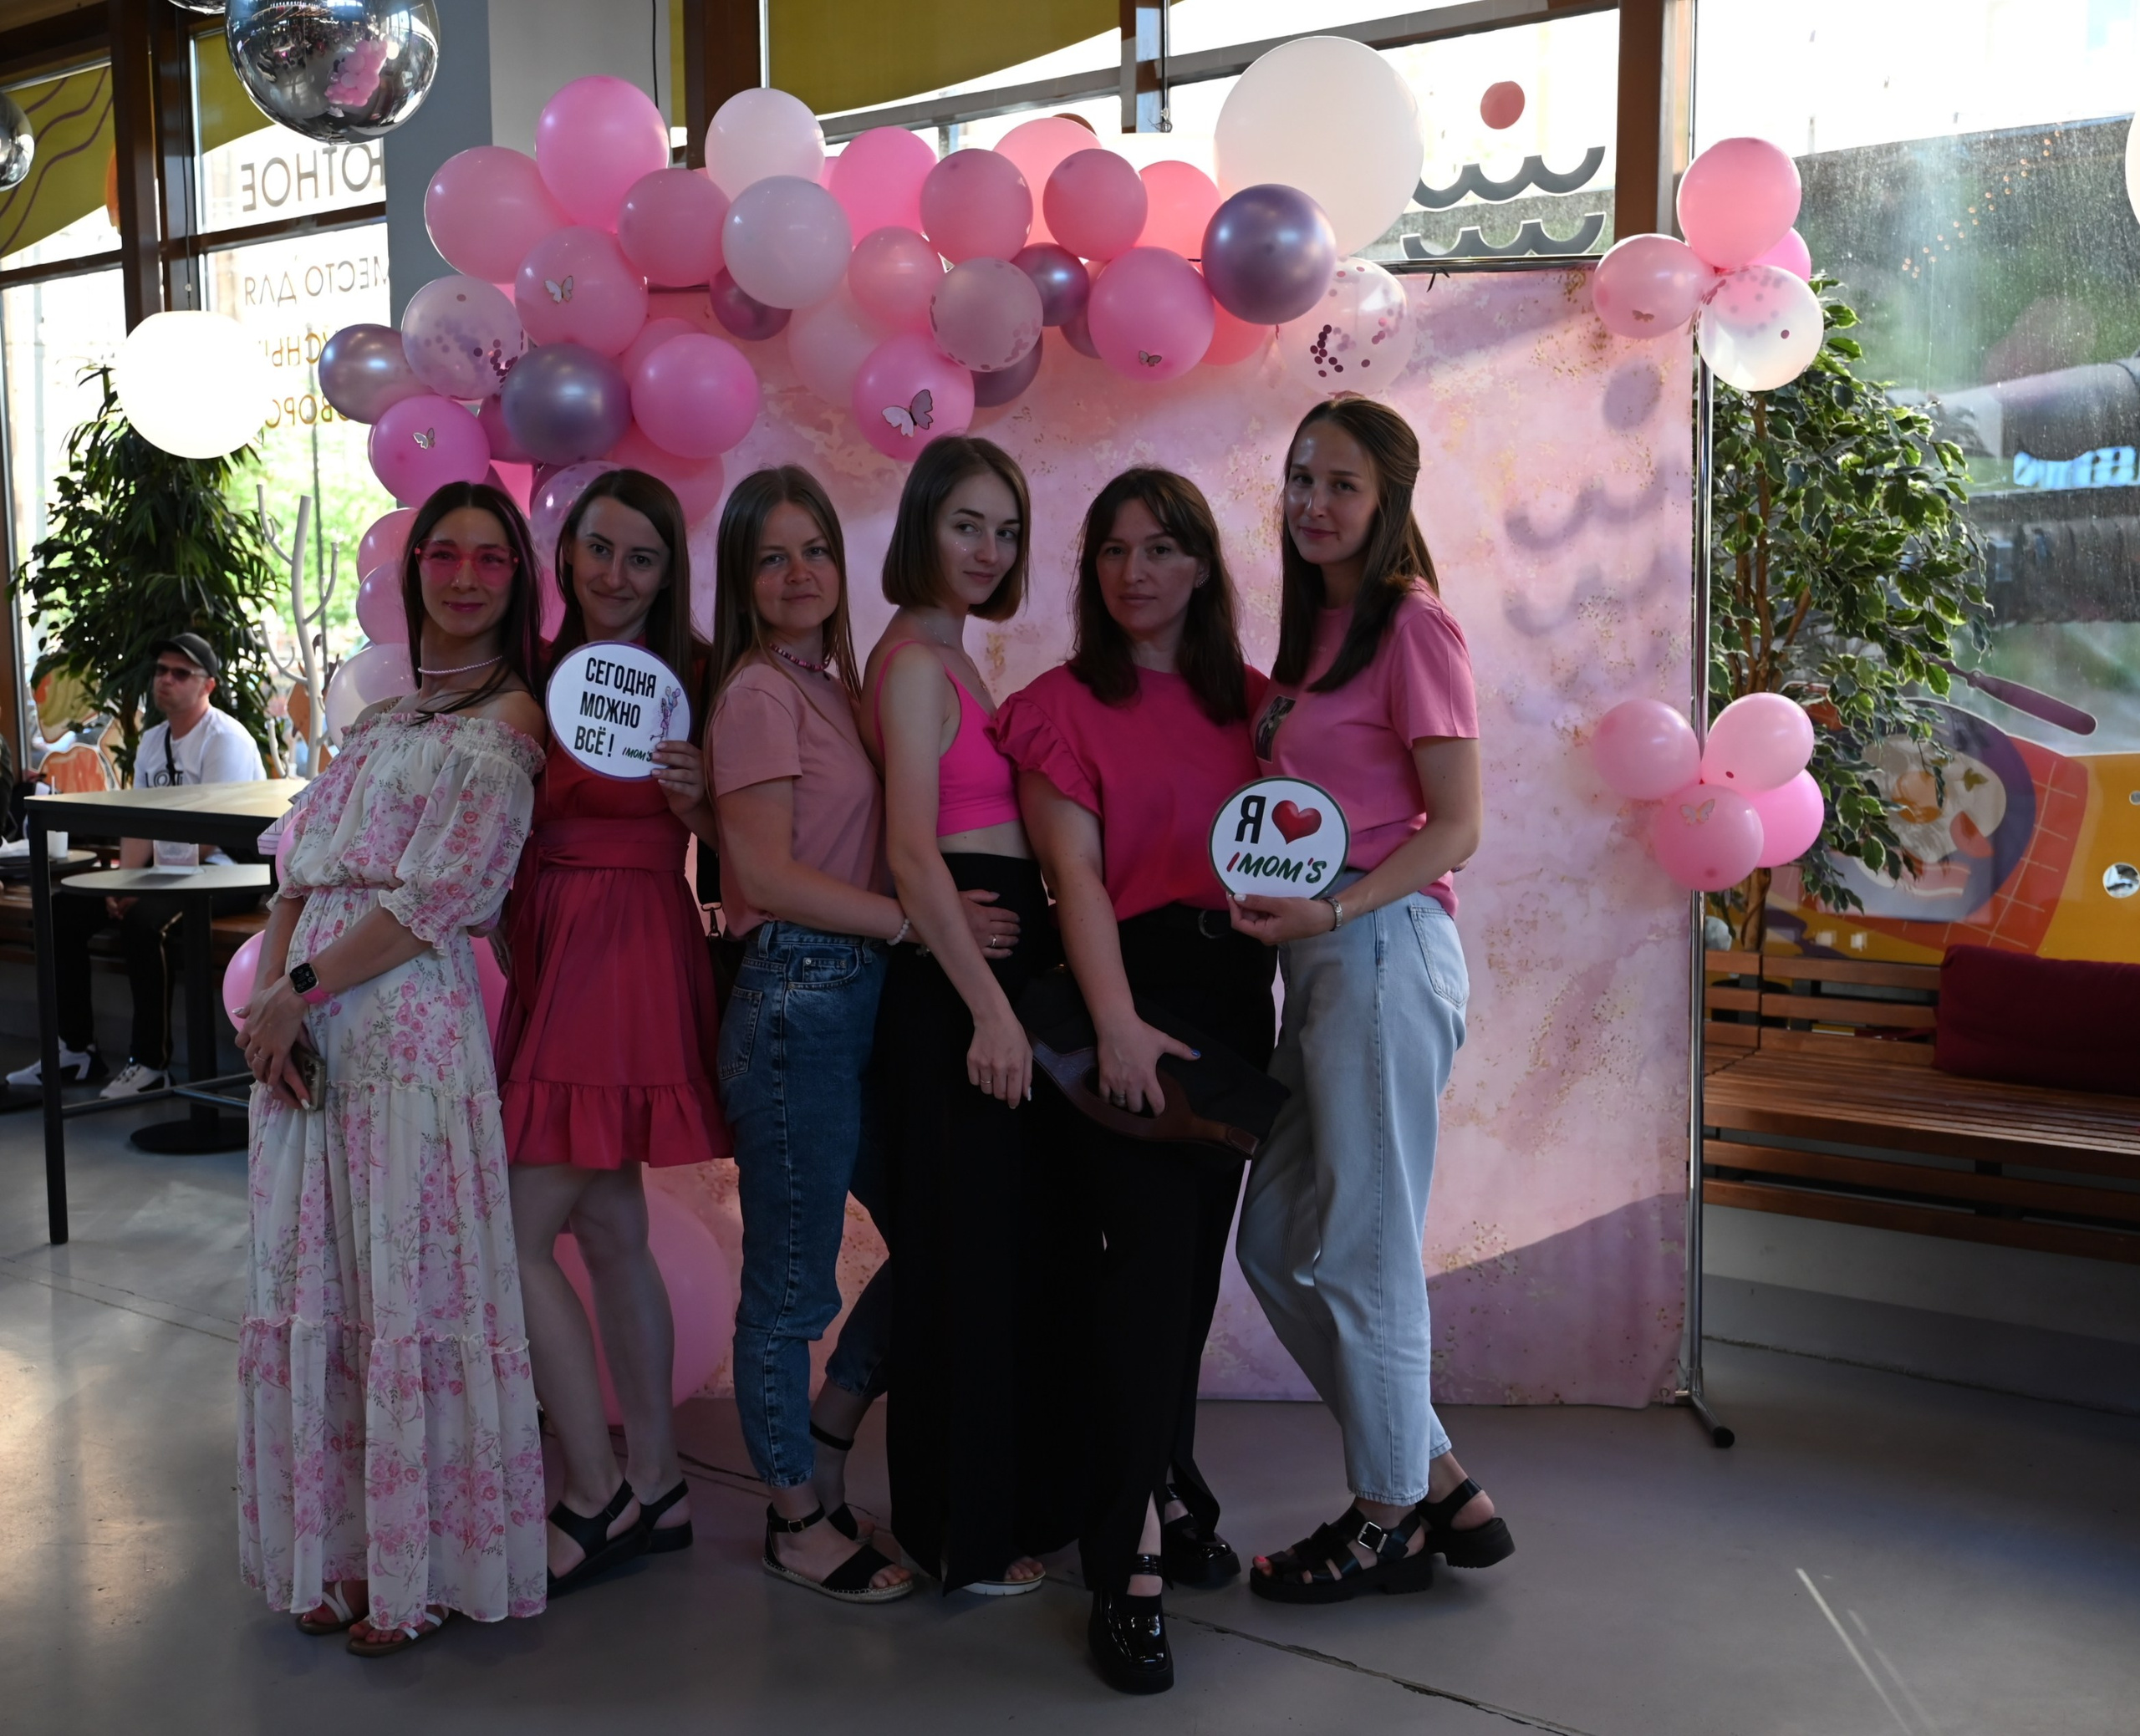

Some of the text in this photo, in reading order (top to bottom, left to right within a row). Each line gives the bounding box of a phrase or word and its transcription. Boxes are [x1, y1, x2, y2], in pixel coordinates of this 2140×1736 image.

[585, 657, 657, 698] СЕГОДНЯ
[579, 691, 641, 729] МОЖНО
[1235, 795, 1266, 844] Я
